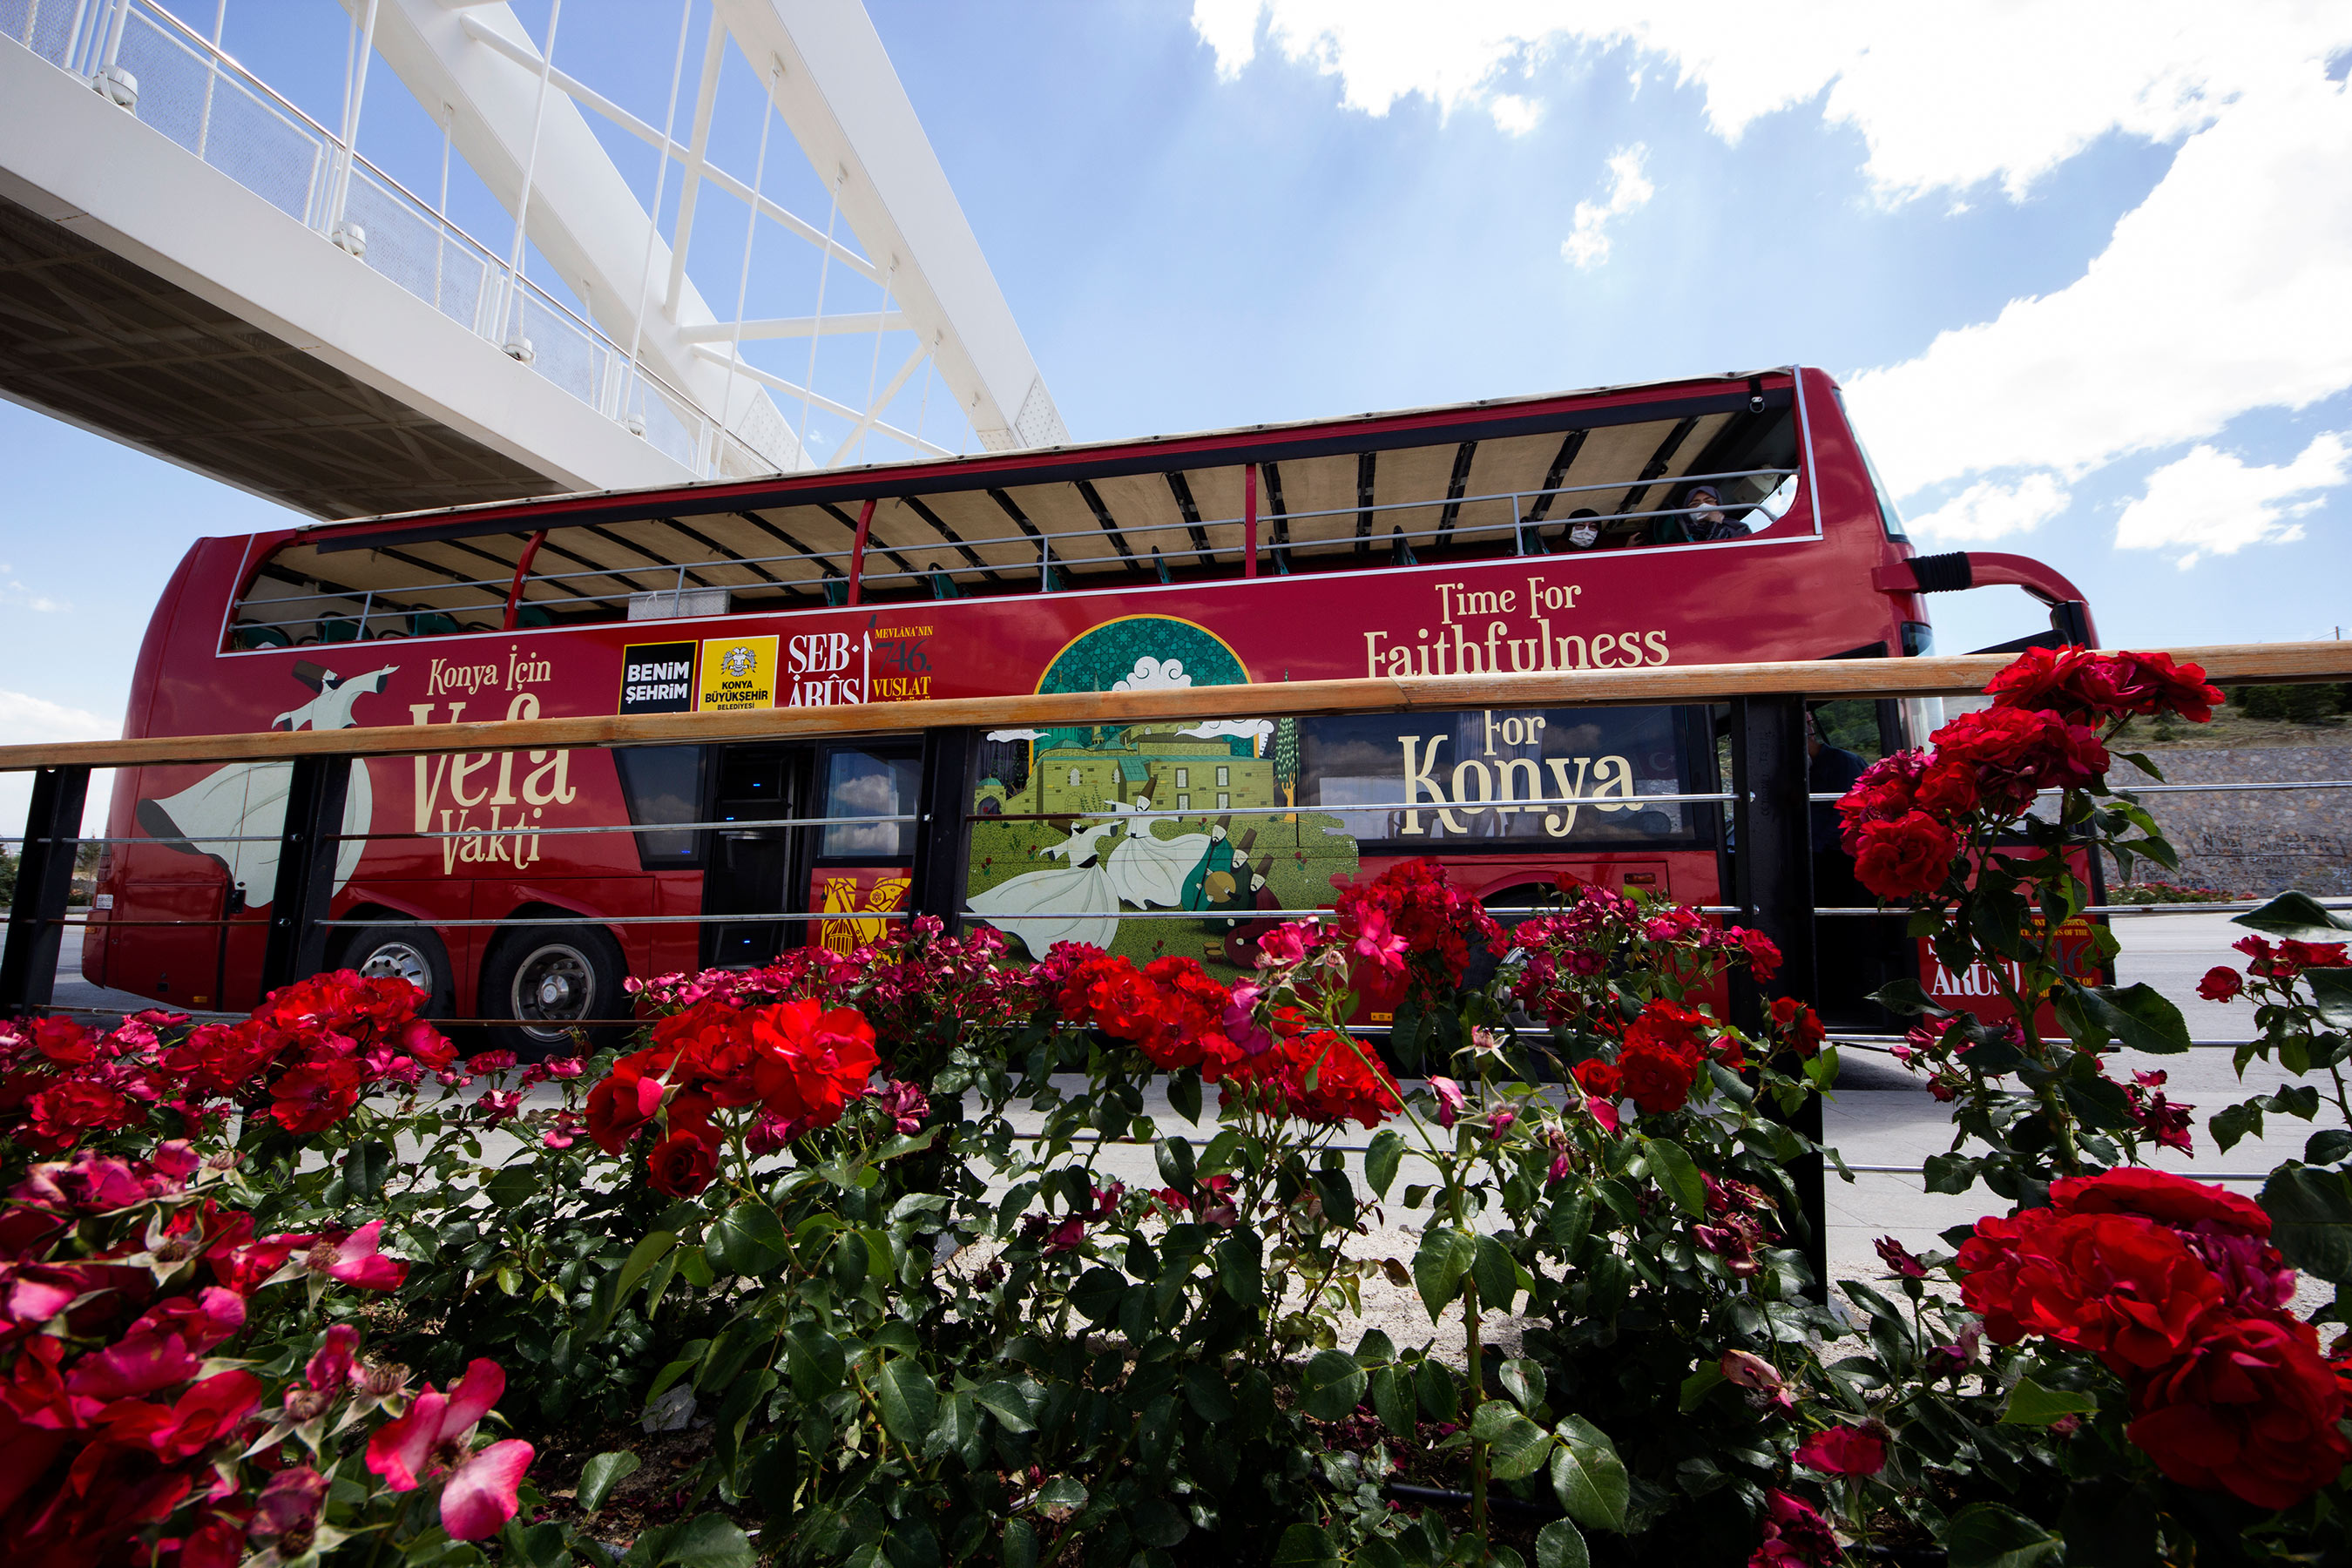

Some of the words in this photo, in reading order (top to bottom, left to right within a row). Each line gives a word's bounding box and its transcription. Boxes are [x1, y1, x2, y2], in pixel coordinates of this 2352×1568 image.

[1435, 582, 1517, 625] Time
[1527, 577, 1582, 618] For
[427, 659, 499, 696] Konya
[505, 645, 551, 693] İçin
[1363, 618, 1670, 679] Faithfulness
[705, 688, 768, 704] BÜYÜKŞEHİR
[717, 702, 755, 711] BELEDİYESİ
[721, 680, 754, 691] KONYA
[872, 676, 932, 698] VUSLAT
[1484, 709, 1547, 756] For
[409, 693, 577, 833] Vefa
[1397, 734, 1648, 838] Konya
[440, 806, 543, 875] Vakti
